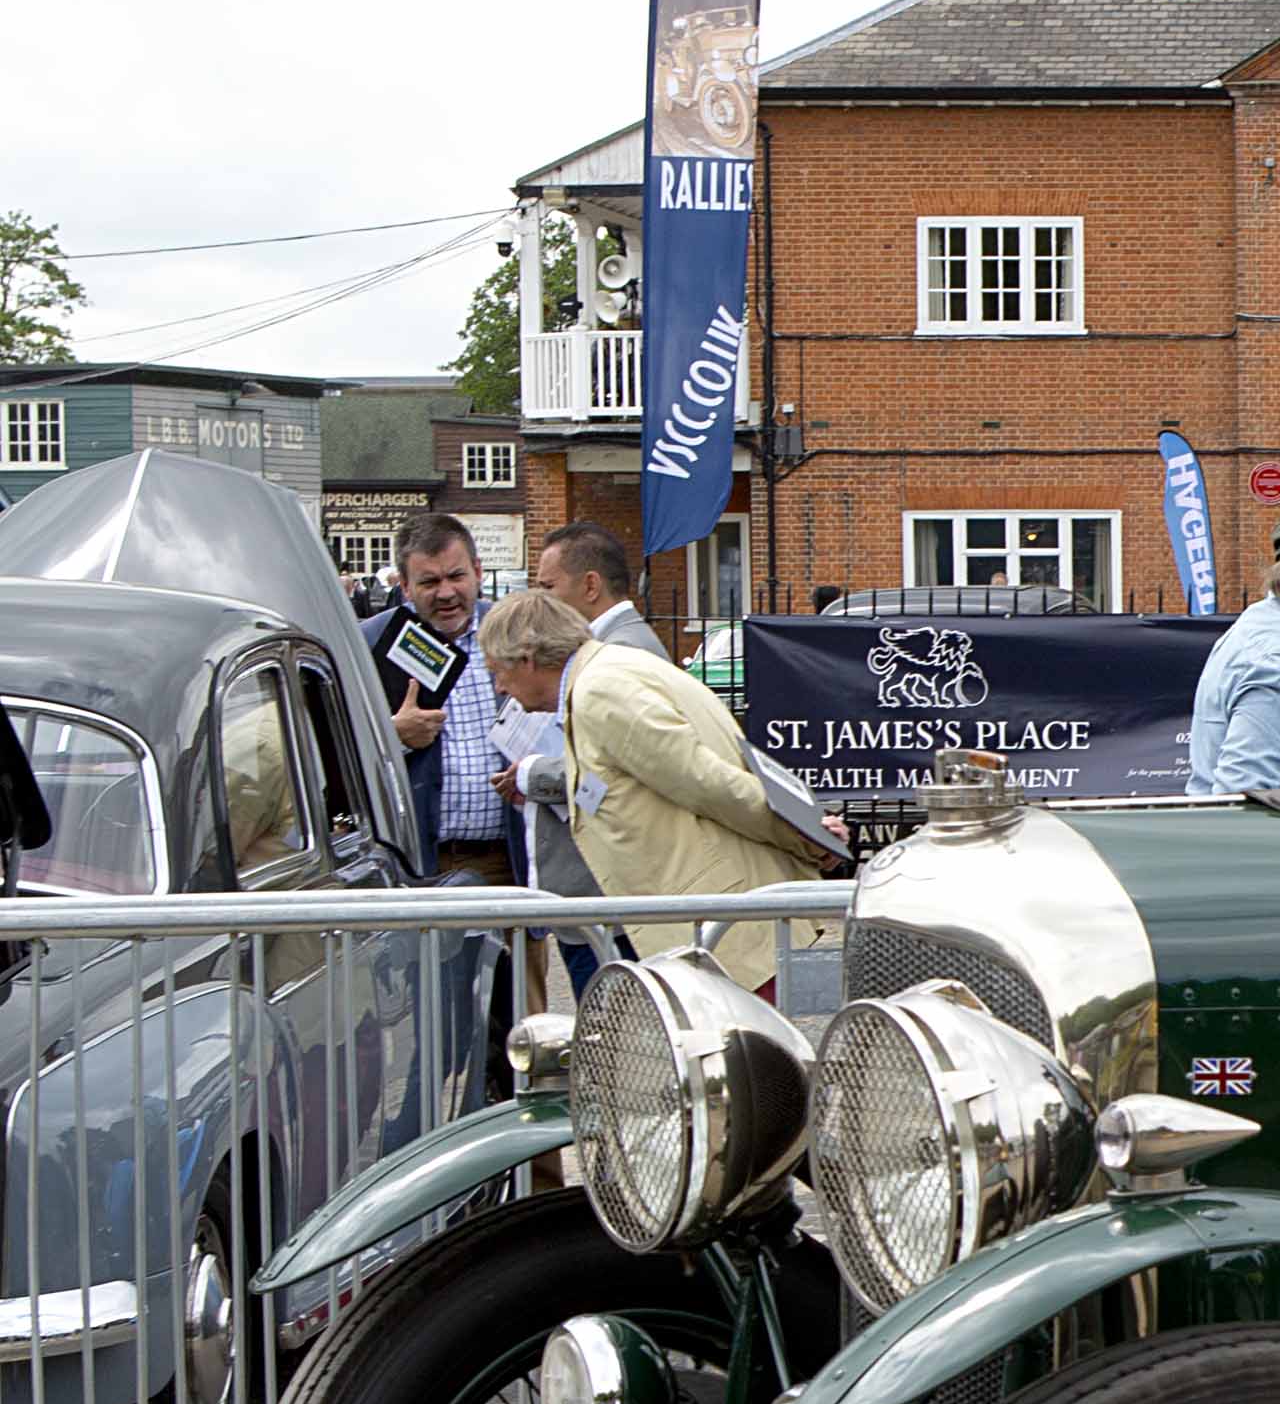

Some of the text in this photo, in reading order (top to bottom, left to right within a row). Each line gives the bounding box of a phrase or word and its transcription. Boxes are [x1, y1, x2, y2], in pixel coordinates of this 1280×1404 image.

[199, 418, 273, 449] MOTORS
[321, 492, 428, 507] UPERCHARGERS
[766, 720, 1091, 759] ST. JAMES'S PLACE
[896, 767, 1080, 789] MAMENT
